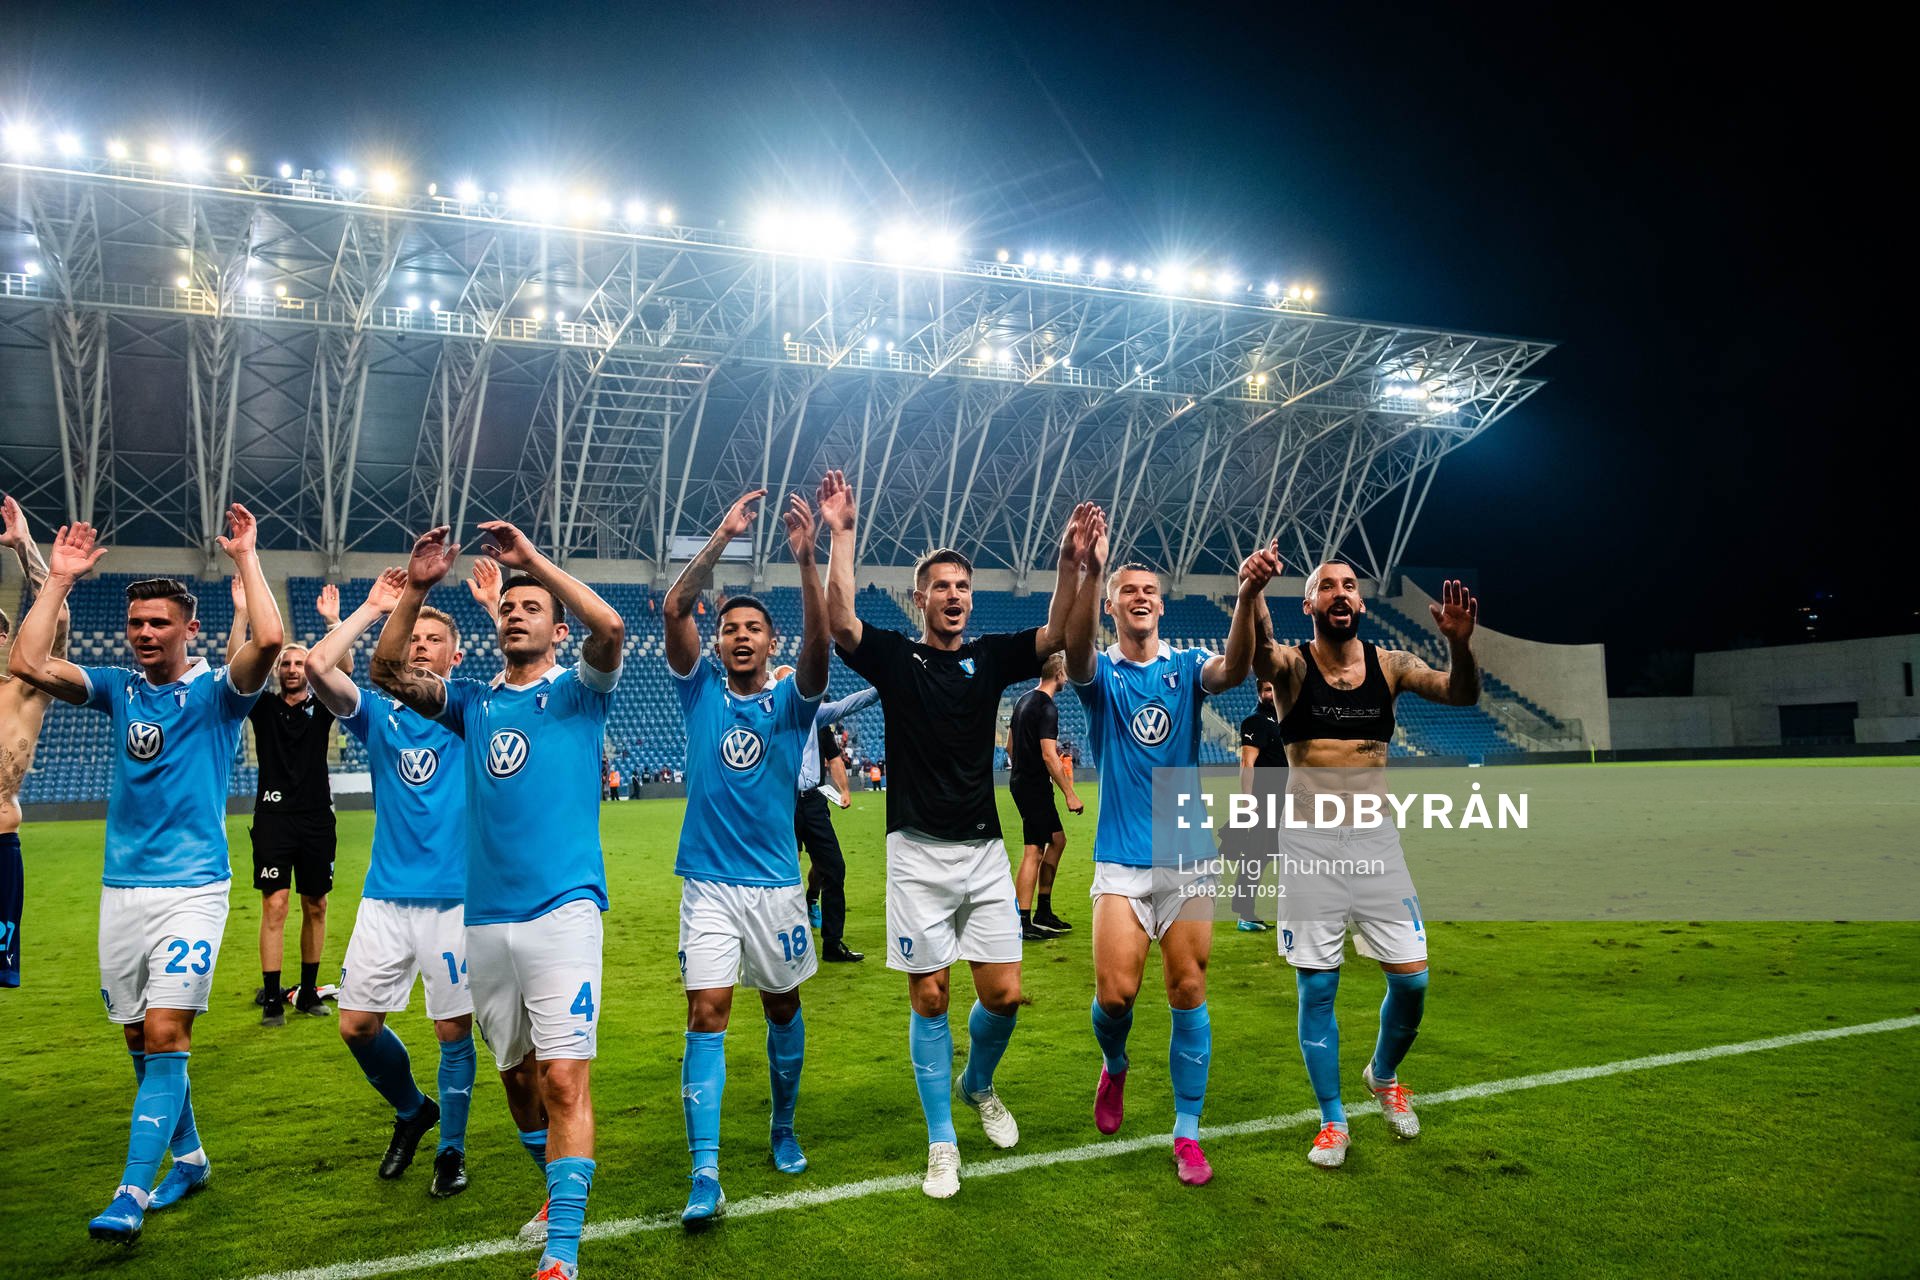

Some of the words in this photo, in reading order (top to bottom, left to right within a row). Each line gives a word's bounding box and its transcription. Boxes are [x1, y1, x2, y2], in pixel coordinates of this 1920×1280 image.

[128, 722, 160, 759] VW
[1132, 706, 1170, 744] VW
[400, 749, 437, 783] VW
[490, 731, 528, 775] VW
[722, 729, 761, 768] VW
[263, 790, 282, 802] AG
[260, 867, 279, 879] AG
[165, 939, 212, 976] 23
[777, 925, 808, 963] 18
[570, 981, 595, 1022] 4
